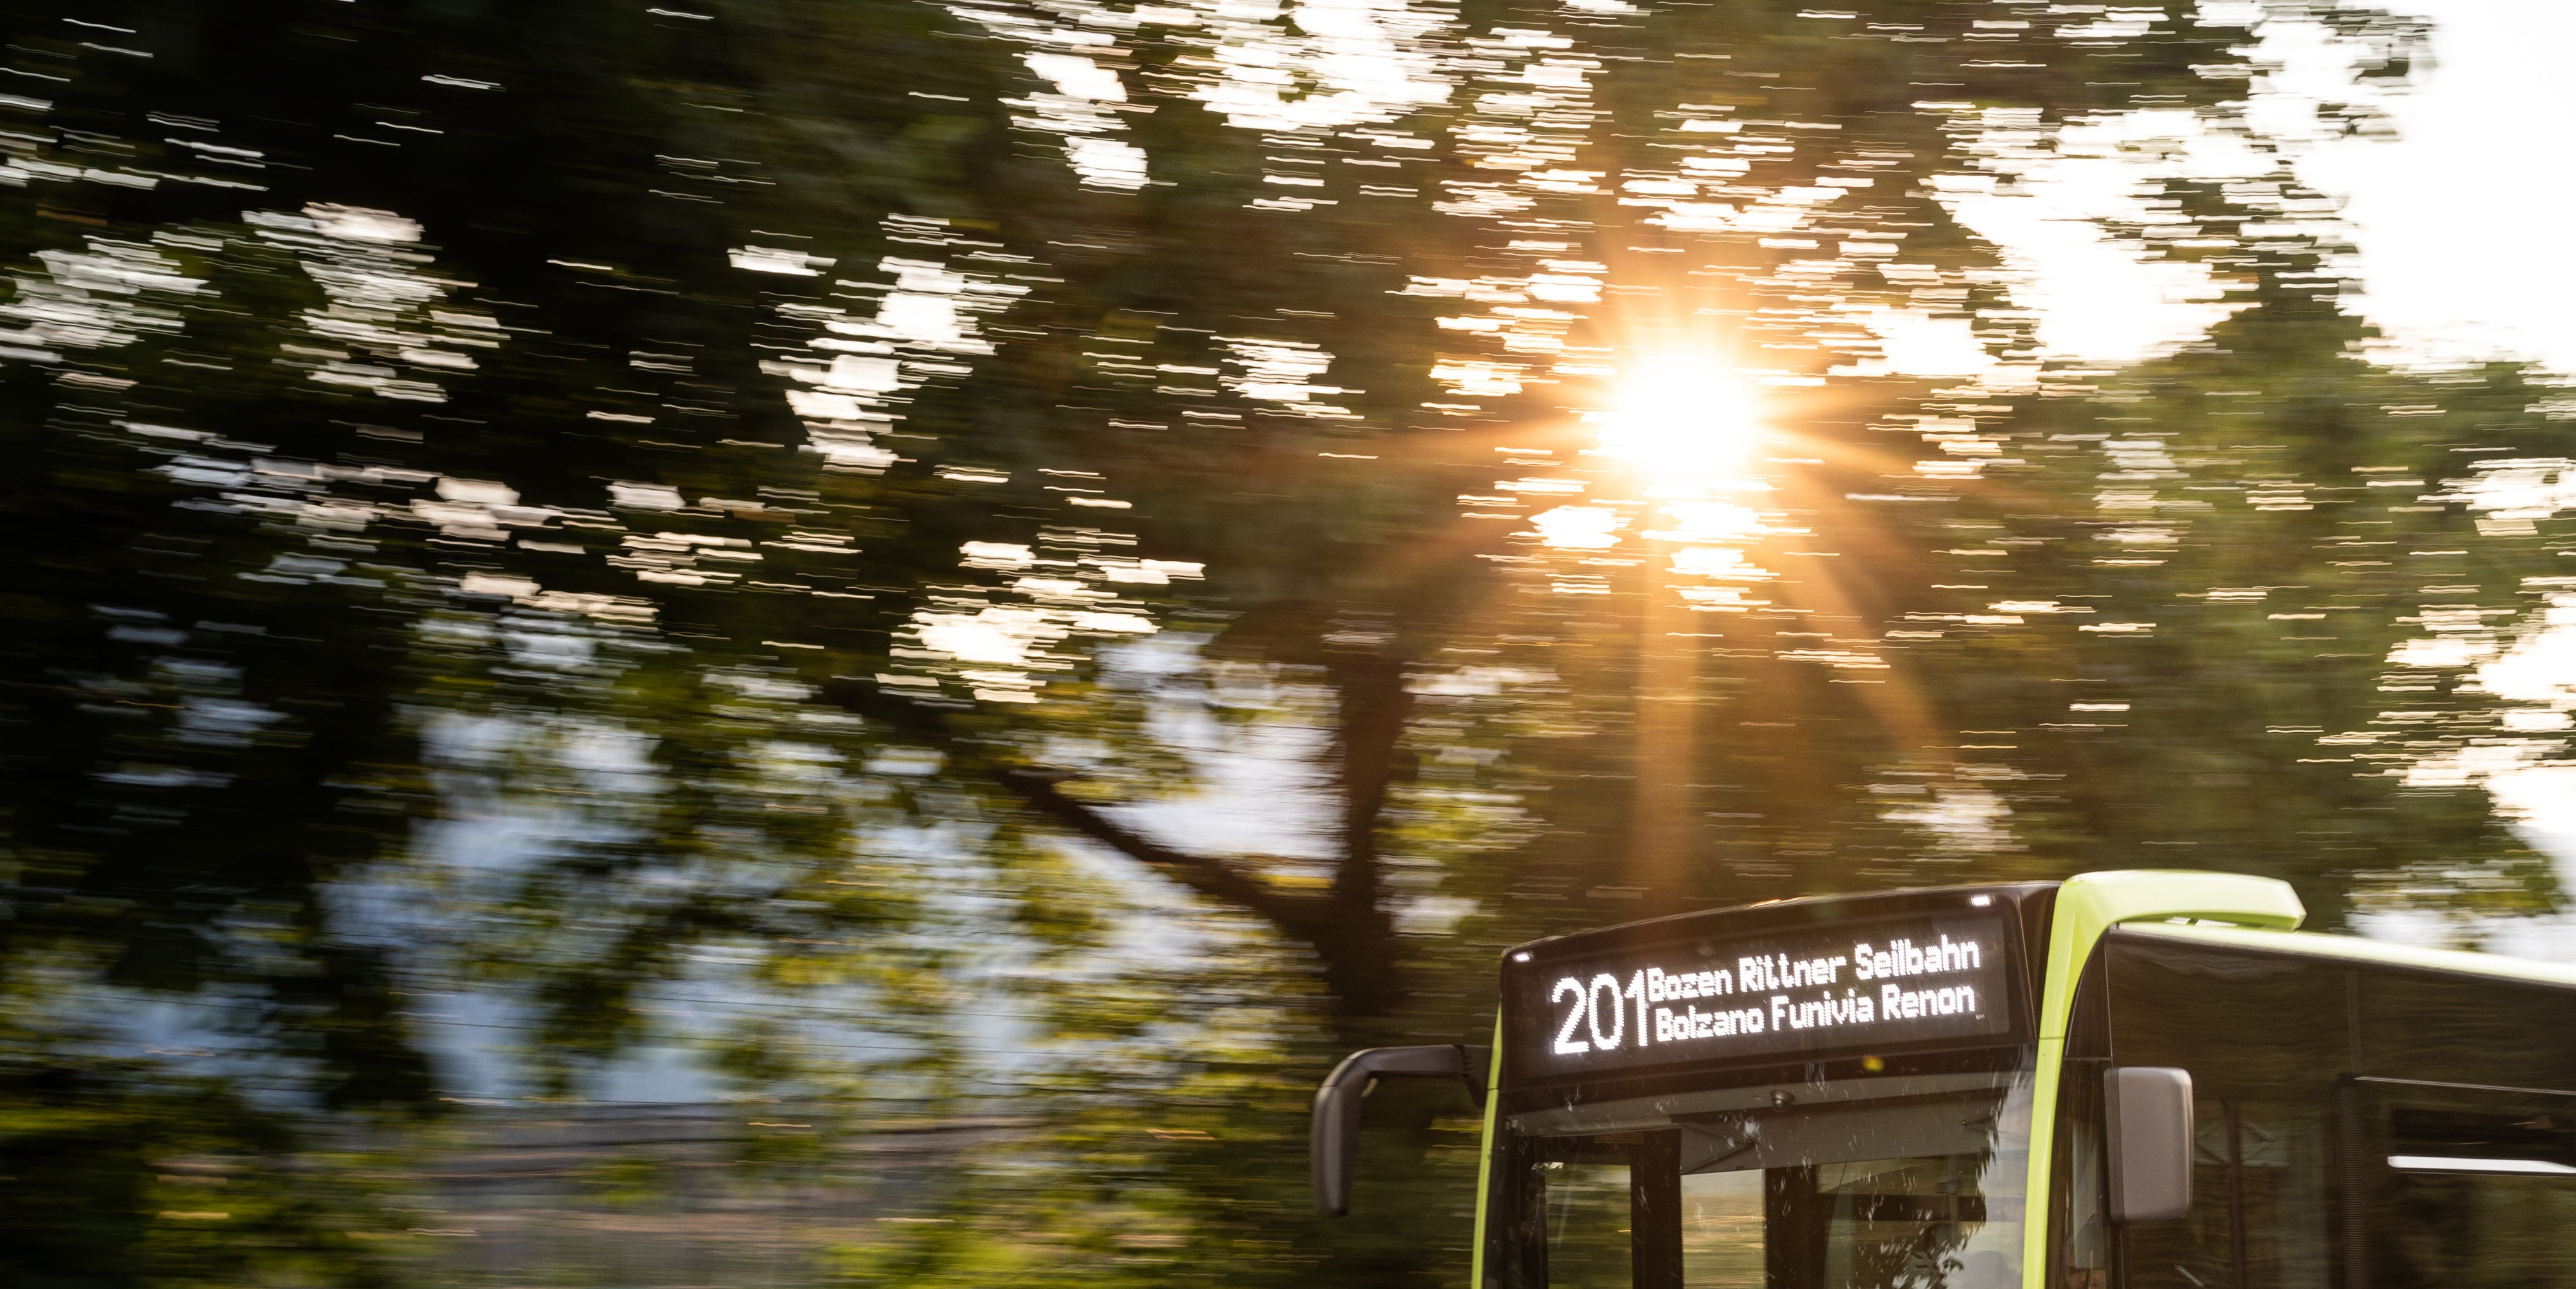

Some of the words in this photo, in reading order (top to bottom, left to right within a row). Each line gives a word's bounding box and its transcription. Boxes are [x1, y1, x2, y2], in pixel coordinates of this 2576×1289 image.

[1647, 967, 1732, 1002] Bozen
[1738, 953, 1846, 993] Rittner
[1854, 935, 1981, 980] Seilbahn
[1552, 969, 1648, 1054] 201
[1655, 1005, 1765, 1042] Bolzano
[1771, 988, 1874, 1031] Funivia
[1879, 984, 1976, 1020] Renon
